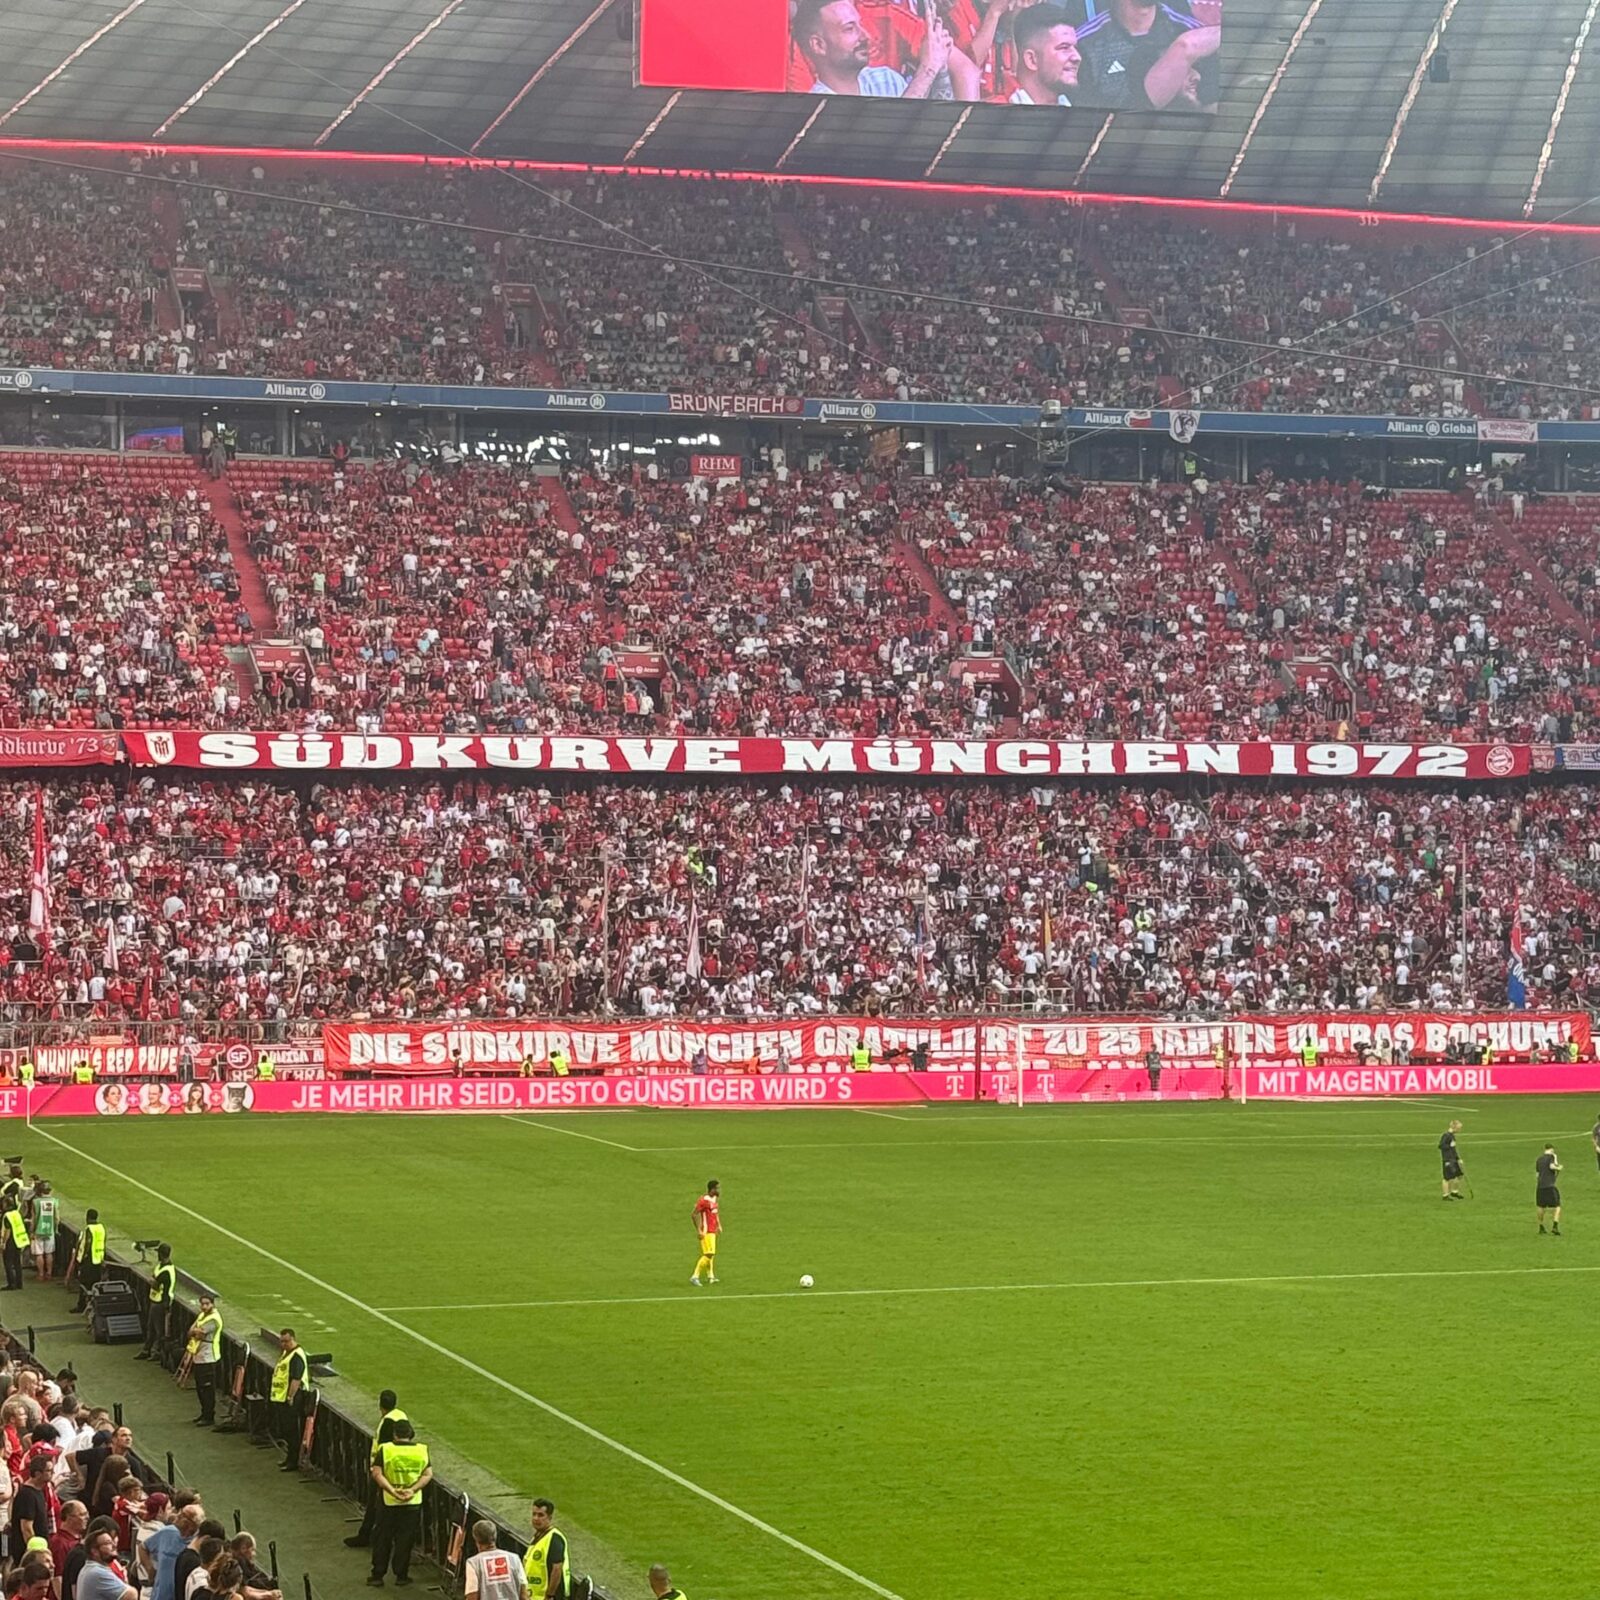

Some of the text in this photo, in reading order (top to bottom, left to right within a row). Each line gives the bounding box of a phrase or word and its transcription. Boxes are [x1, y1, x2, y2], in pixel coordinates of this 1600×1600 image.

[264, 383, 307, 398] Allianz
[547, 394, 588, 408] Allianz
[820, 403, 859, 417] Allianz
[1084, 412, 1123, 425] Allianz
[1387, 421, 1425, 433] Allianz
[1442, 422, 1477, 434] Global
[699, 457, 736, 471] RHM
[70, 737, 99, 754] '73
[198, 732, 742, 772] SÜDKURVE
[780, 740, 1241, 774] MÜNCHEN
[1269, 743, 1469, 778] 1972
[348, 1032, 412, 1066] DIE
[421, 1024, 620, 1064] SÜDKURVE
[629, 1024, 804, 1064] MÜNCHEN
[1044, 1028, 1088, 1056] ZU
[1100, 1028, 1141, 1056] 25
[1286, 1022, 1415, 1054] ULTRAS
[138, 1045, 178, 1074] PRIDE
[229, 1051, 248, 1064] SF
[1258, 1067, 1498, 1093] MIT MAGENTA MOBIL
[292, 1084, 322, 1108] JE
[330, 1083, 404, 1108] MEHR
[410, 1082, 453, 1106] IHR
[459, 1081, 522, 1108] SEID,
[529, 1081, 609, 1105] DESTO
[615, 1075, 755, 1104] GÜNSTIGER
